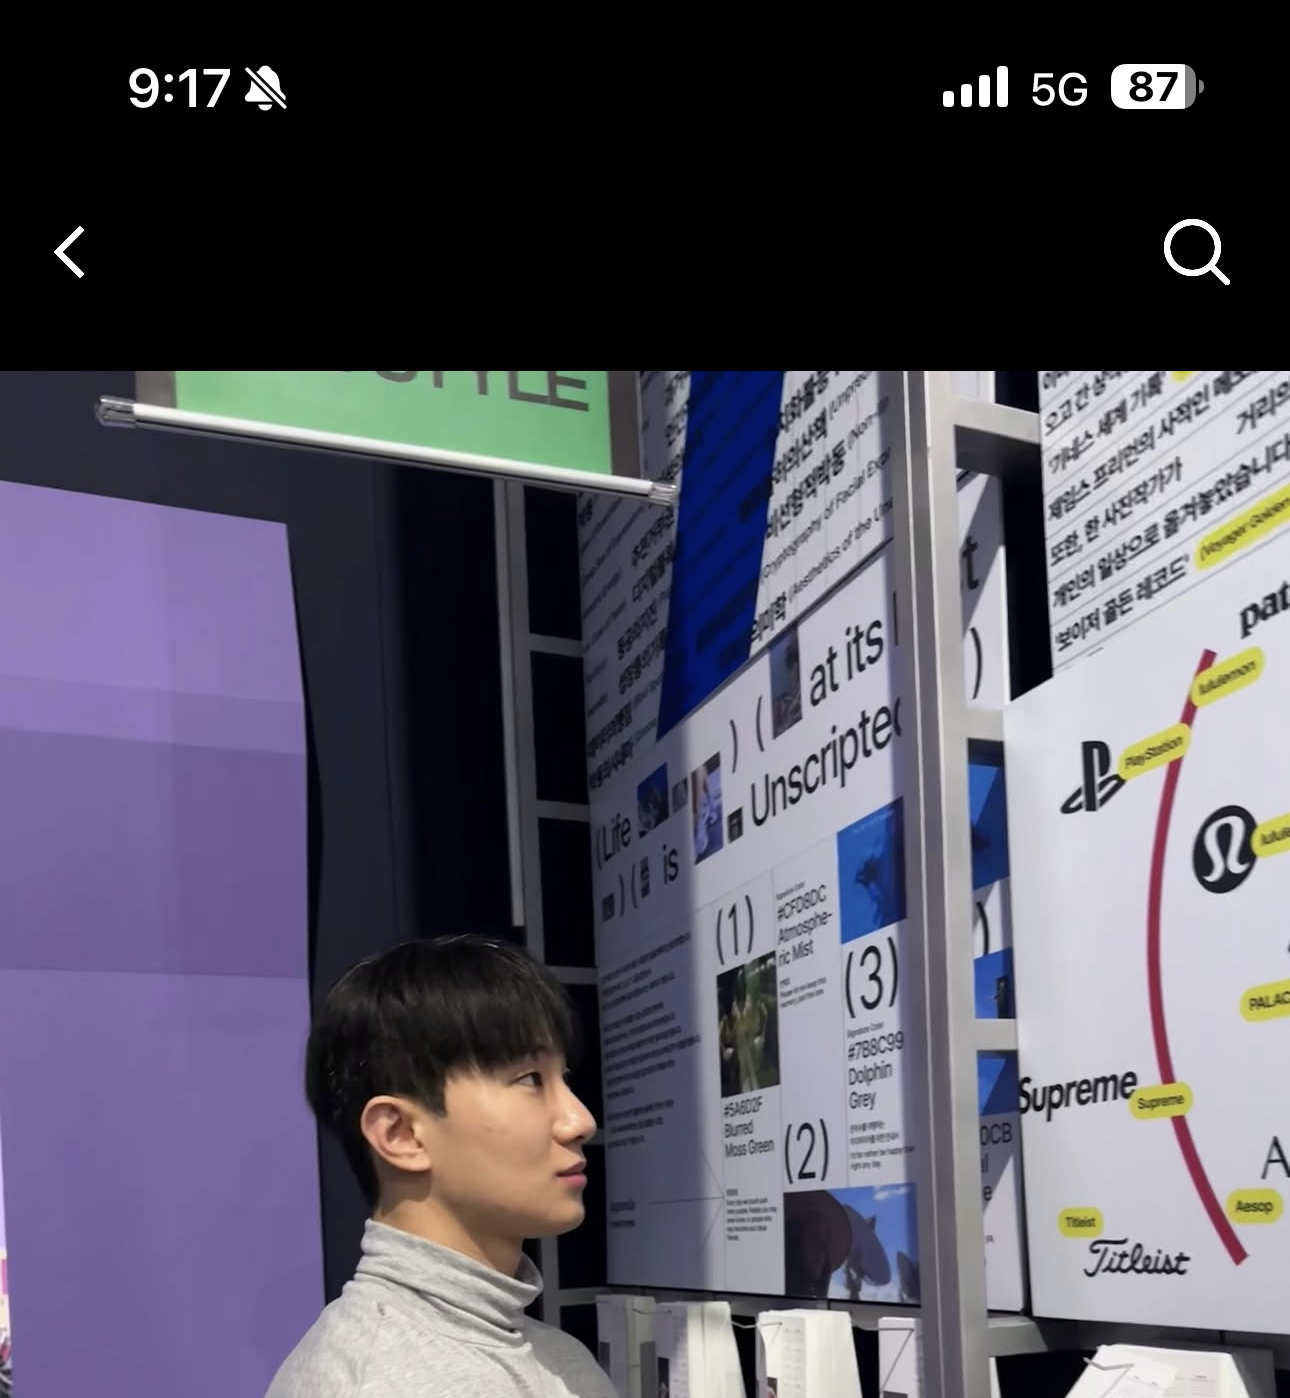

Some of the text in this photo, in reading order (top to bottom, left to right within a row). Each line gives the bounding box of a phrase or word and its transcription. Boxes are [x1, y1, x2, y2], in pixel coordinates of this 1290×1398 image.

[1097, 398, 1127, 438] 세계
[1048, 479, 1092, 521] 제임스
[1093, 425, 1154, 490] 프리먼의
[1158, 383, 1210, 439] 사적인
[1084, 515, 1100, 544] 한
[1102, 456, 1182, 529] 사진작가가
[1053, 564, 1096, 608] 개인의
[1098, 523, 1161, 581] 일상으로
[1103, 587, 1133, 626] 골든
[594, 811, 632, 870] (Life
[809, 646, 840, 707] at
[843, 619, 883, 682] its
[1124, 735, 1184, 769] PlayStation
[662, 843, 679, 885] is
[715, 894, 755, 966] (1)
[778, 911, 833, 946] Atmosphe-
[779, 938, 814, 967] ric Mist
[845, 937, 899, 1019] (3)
[848, 1030, 905, 1062] #7B8C99
[849, 1060, 893, 1087] Dolphin
[849, 1091, 877, 1110] Grey
[1017, 1070, 1139, 1122] Supreme
[1137, 1093, 1184, 1111] Supreme
[725, 1119, 754, 1139] Blurred
[725, 1138, 775, 1158] Moss Green
[784, 1118, 829, 1185] (2)
[1065, 1215, 1096, 1228] Titleist
[1235, 1198, 1275, 1215] Aesop
[1083, 1238, 1191, 1277] Titleist
